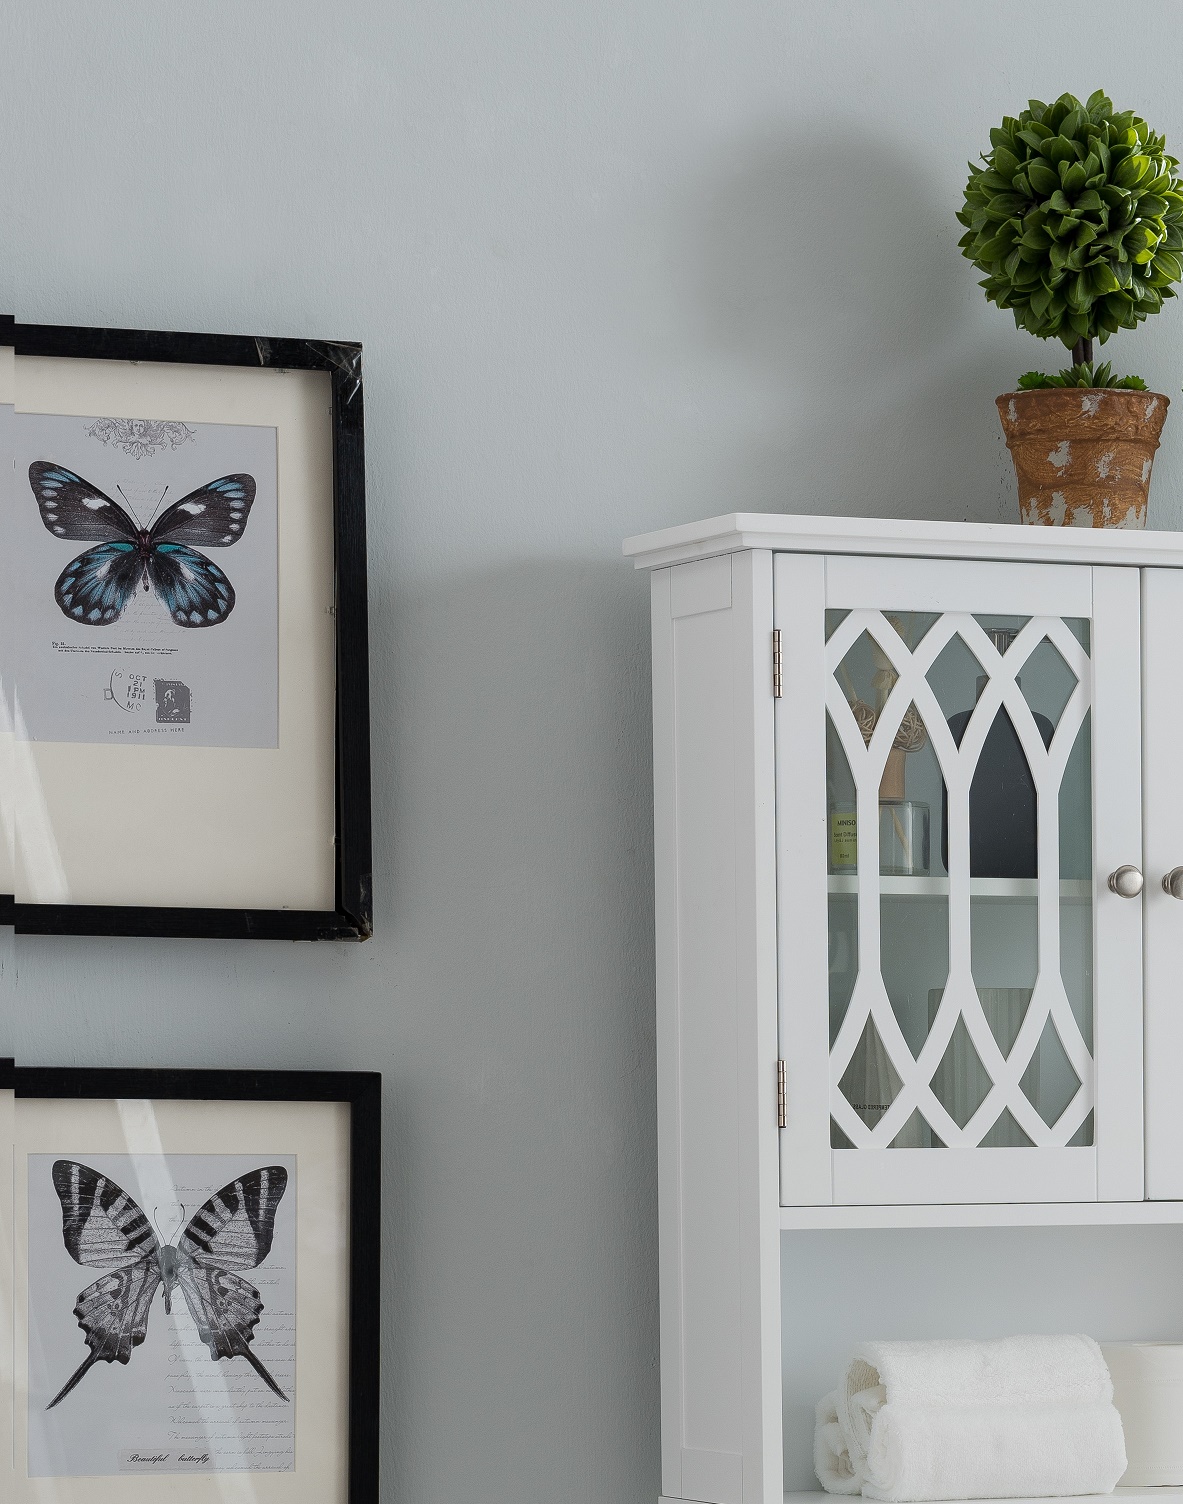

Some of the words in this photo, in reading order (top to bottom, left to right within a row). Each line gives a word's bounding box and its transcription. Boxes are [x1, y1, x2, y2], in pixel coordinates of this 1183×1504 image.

[128, 673, 147, 681] OCT
[126, 1453, 170, 1464] Beautiful
[177, 1453, 210, 1464] butterfly
